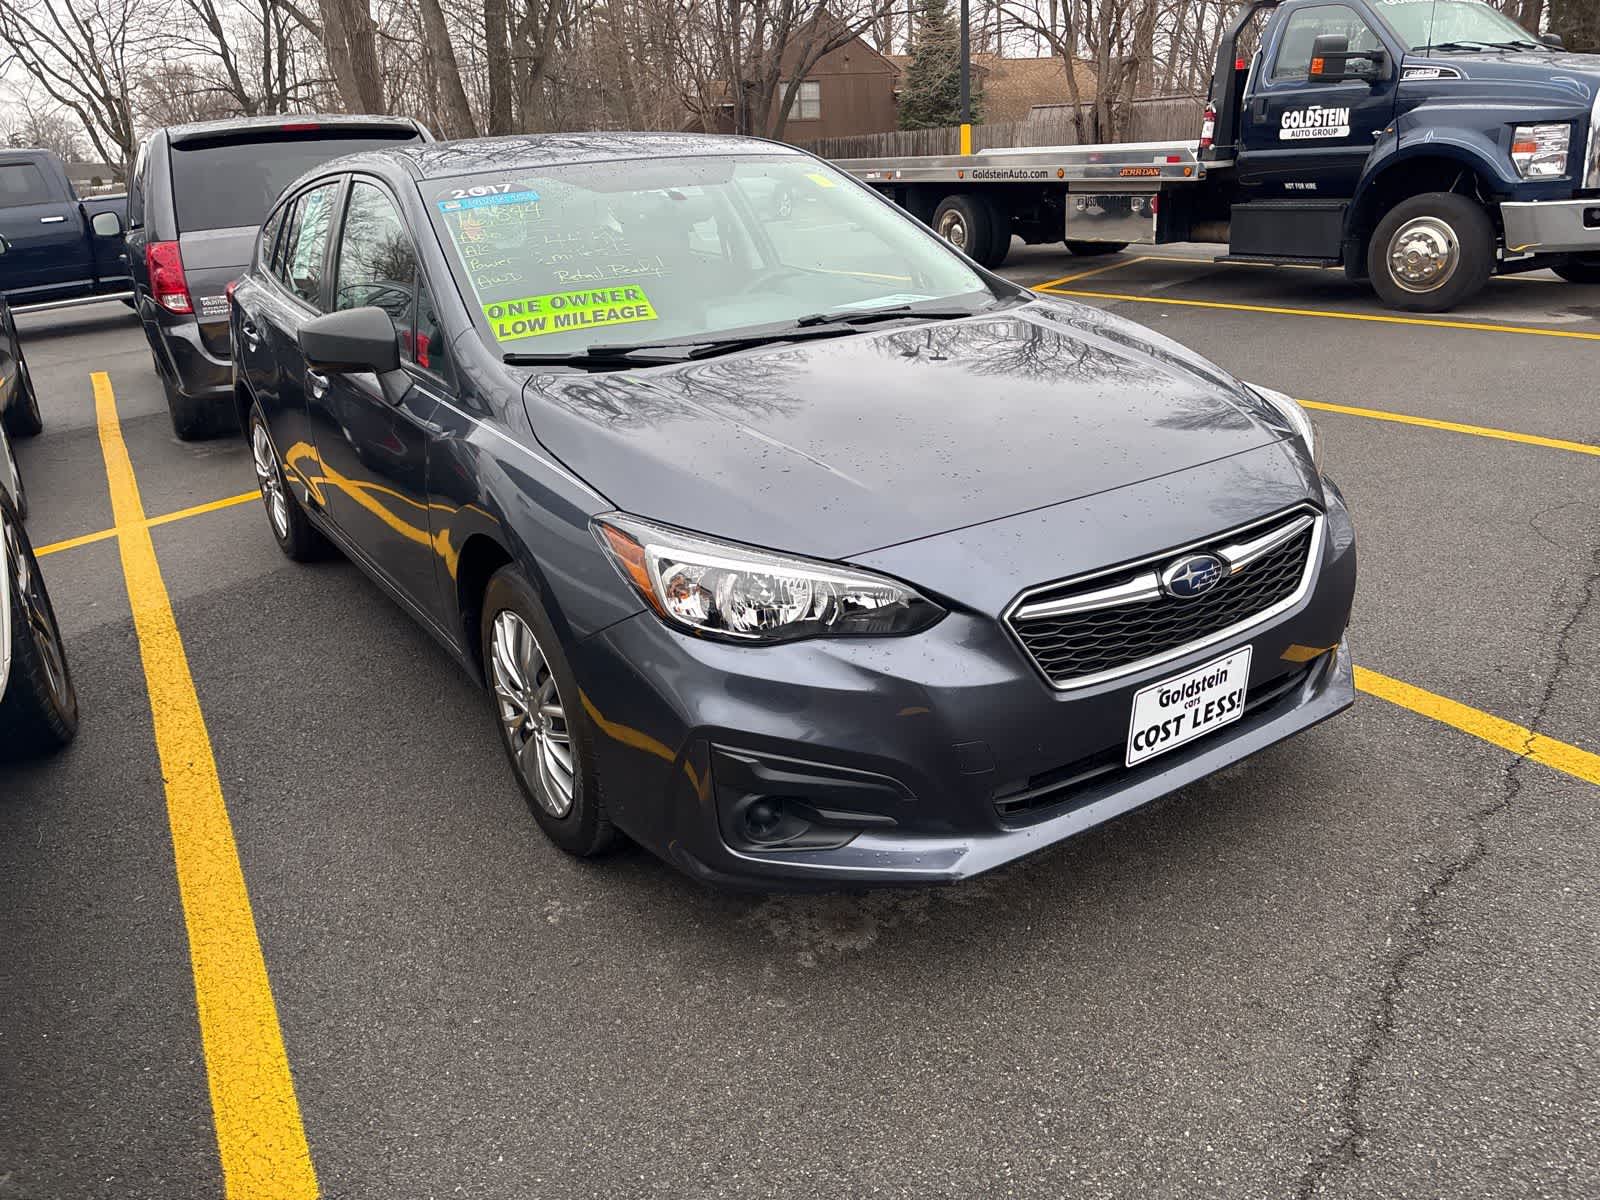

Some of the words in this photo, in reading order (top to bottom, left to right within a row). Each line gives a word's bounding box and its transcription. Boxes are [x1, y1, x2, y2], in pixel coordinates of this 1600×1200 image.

[1281, 107, 1350, 129] GOLDSTEIN
[1291, 130, 1310, 138] AUTO
[1312, 128, 1338, 136] GROUP
[972, 169, 1048, 179] GoldsteinAuto.com
[451, 183, 512, 199] 2017
[1284, 182, 1294, 190] NOT
[1295, 182, 1304, 190] FOR
[1305, 182, 1317, 190] HIRE
[487, 300, 542, 319] ONE
[551, 288, 642, 310] OWNER
[498, 316, 547, 338] LOW
[553, 304, 649, 329] MILEAGE
[1159, 668, 1228, 708] Goldstein
[1184, 696, 1201, 710] cars
[1133, 713, 1185, 751] COST
[1192, 688, 1243, 729] LESS!
